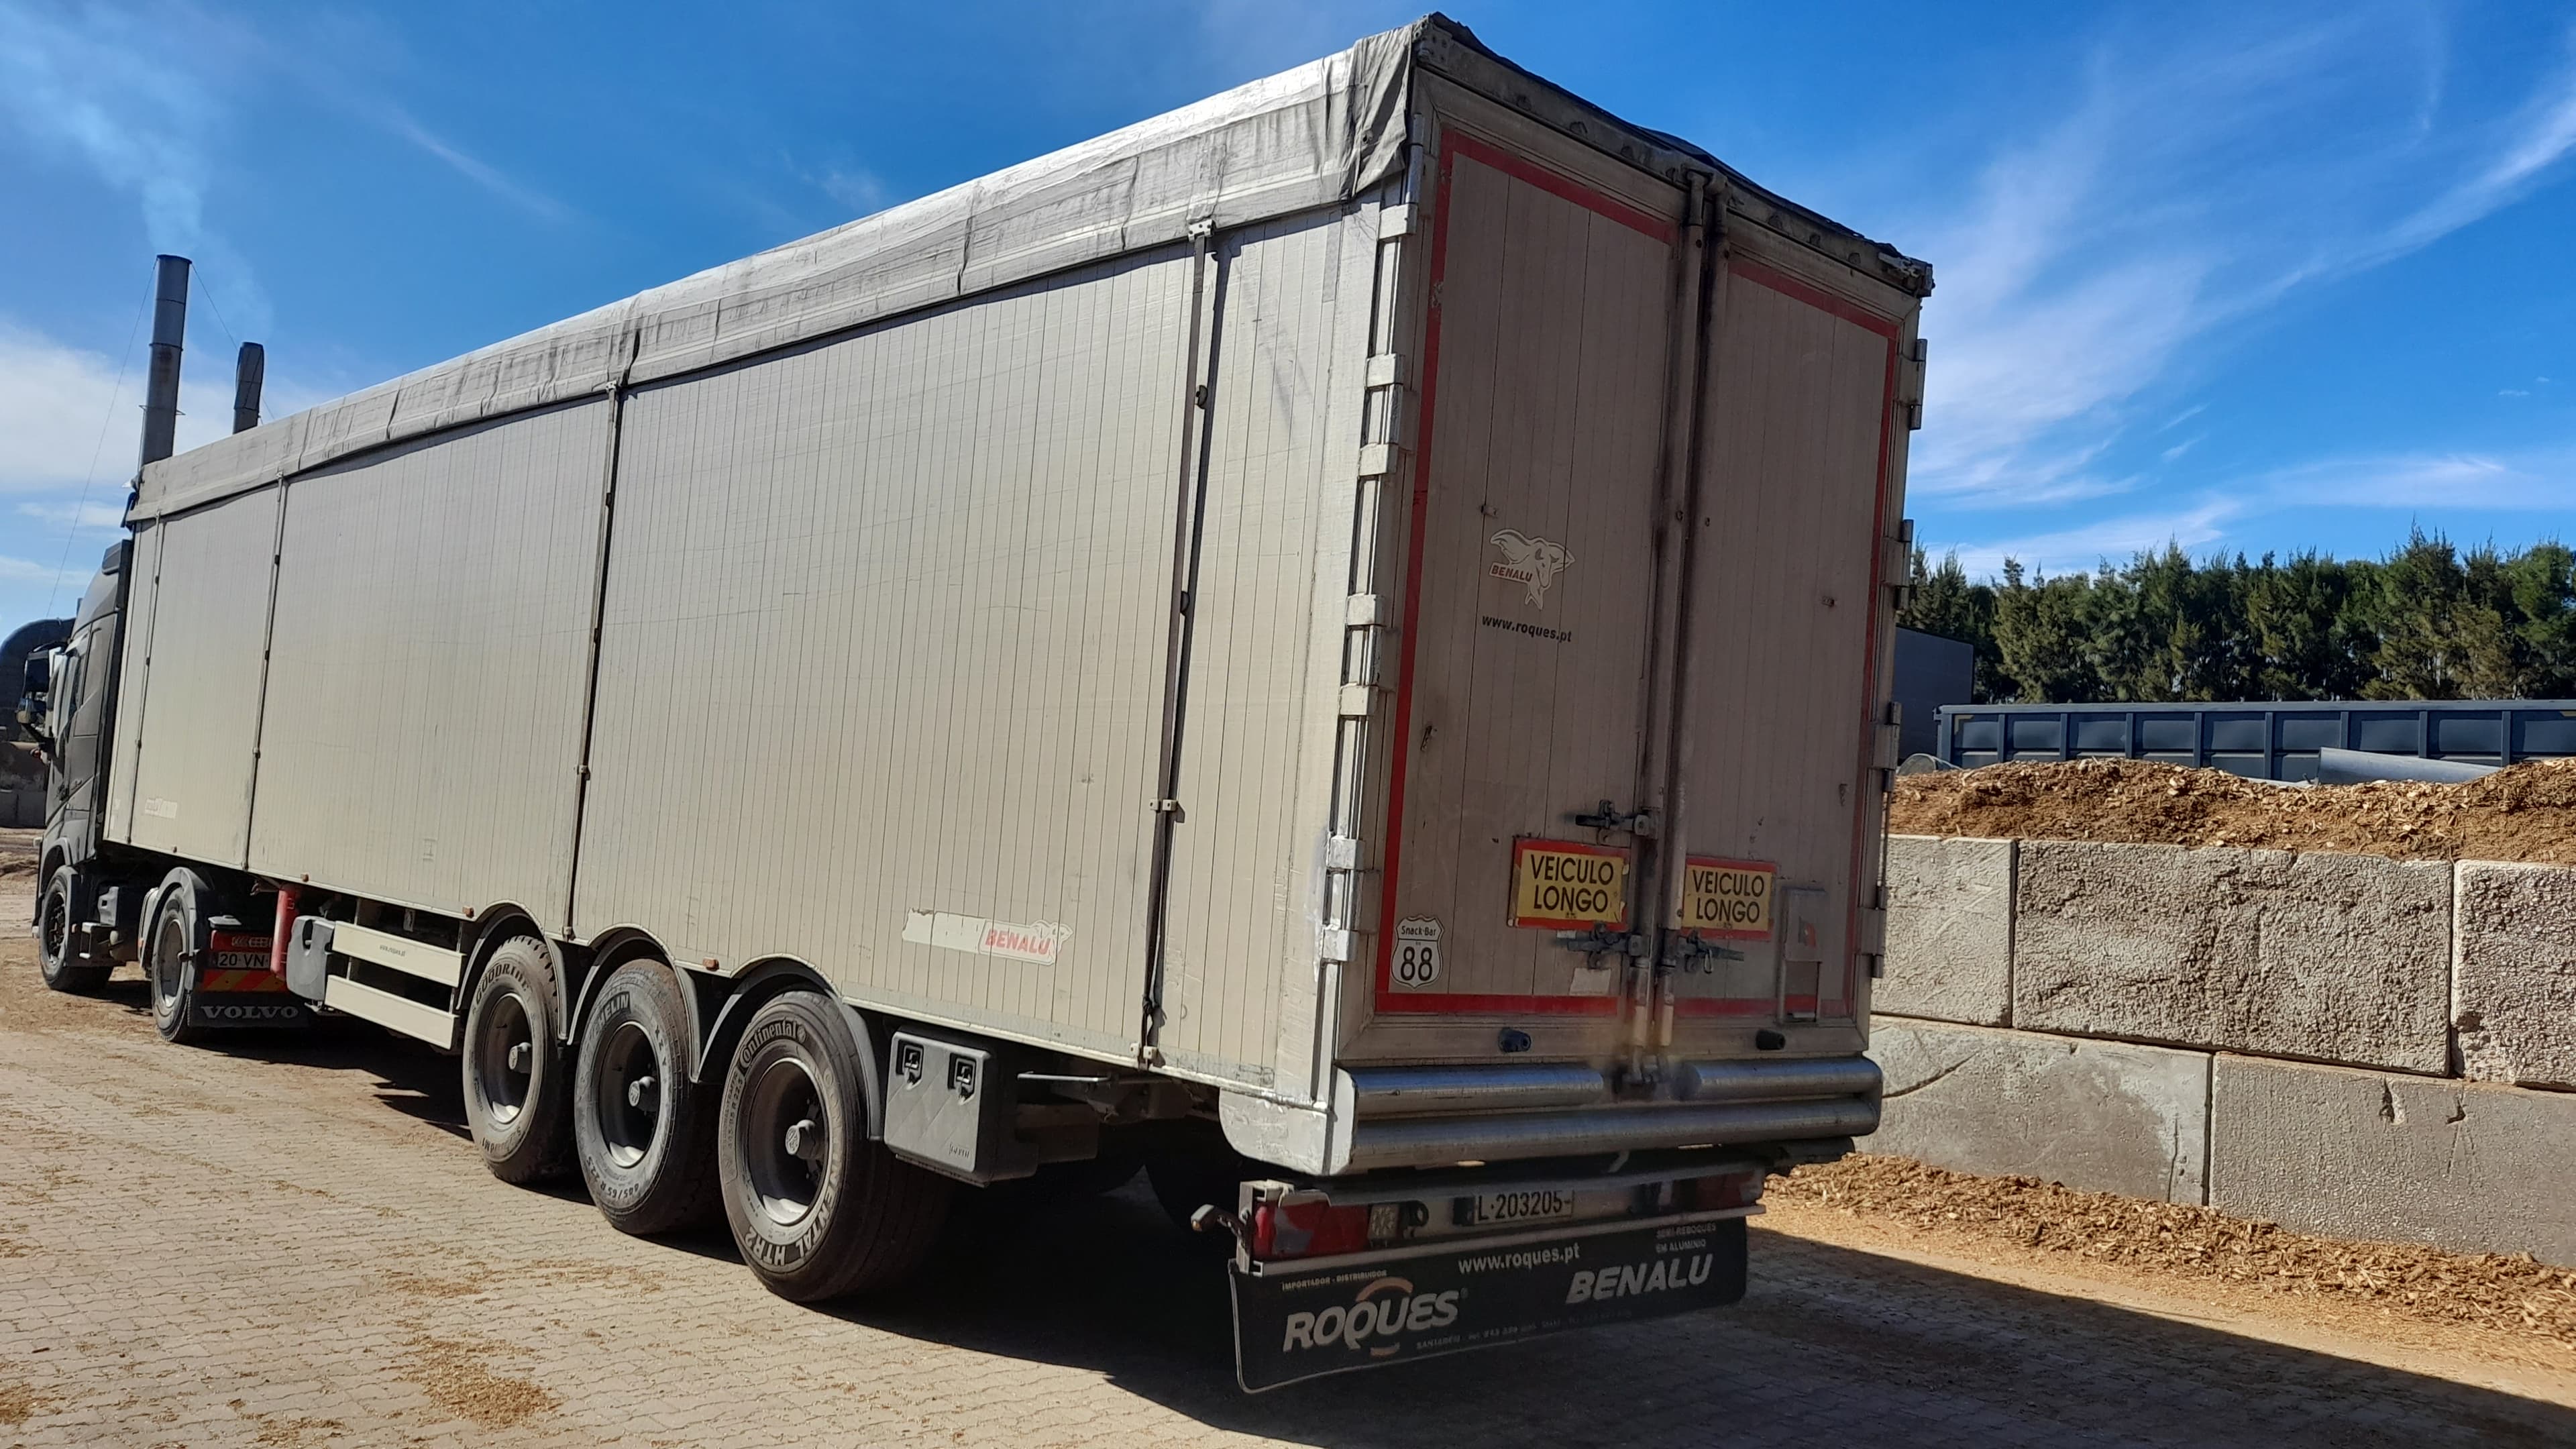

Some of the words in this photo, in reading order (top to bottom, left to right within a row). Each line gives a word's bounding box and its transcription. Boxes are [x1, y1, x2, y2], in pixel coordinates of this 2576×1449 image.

[1491, 565, 1533, 583] BENALU
[1481, 615, 1572, 643] www.roques.pt
[1530, 854, 1614, 885] VEICULO
[1693, 869, 1765, 898] VEICULO
[1534, 885, 1609, 914] LONGO
[1695, 898, 1760, 924] LONGO
[985, 928, 1051, 955] BENALU
[1400, 946, 1433, 981] 88
[200, 1006, 299, 1019] VOLVO
[739, 1019, 797, 1068] Continental
[744, 1225, 786, 1267] HTR2
[1458, 1242, 1580, 1275] www.roques.pt
[1565, 1252, 1714, 1304] BENALU
[1282, 1289, 1459, 1352] ROQUES
